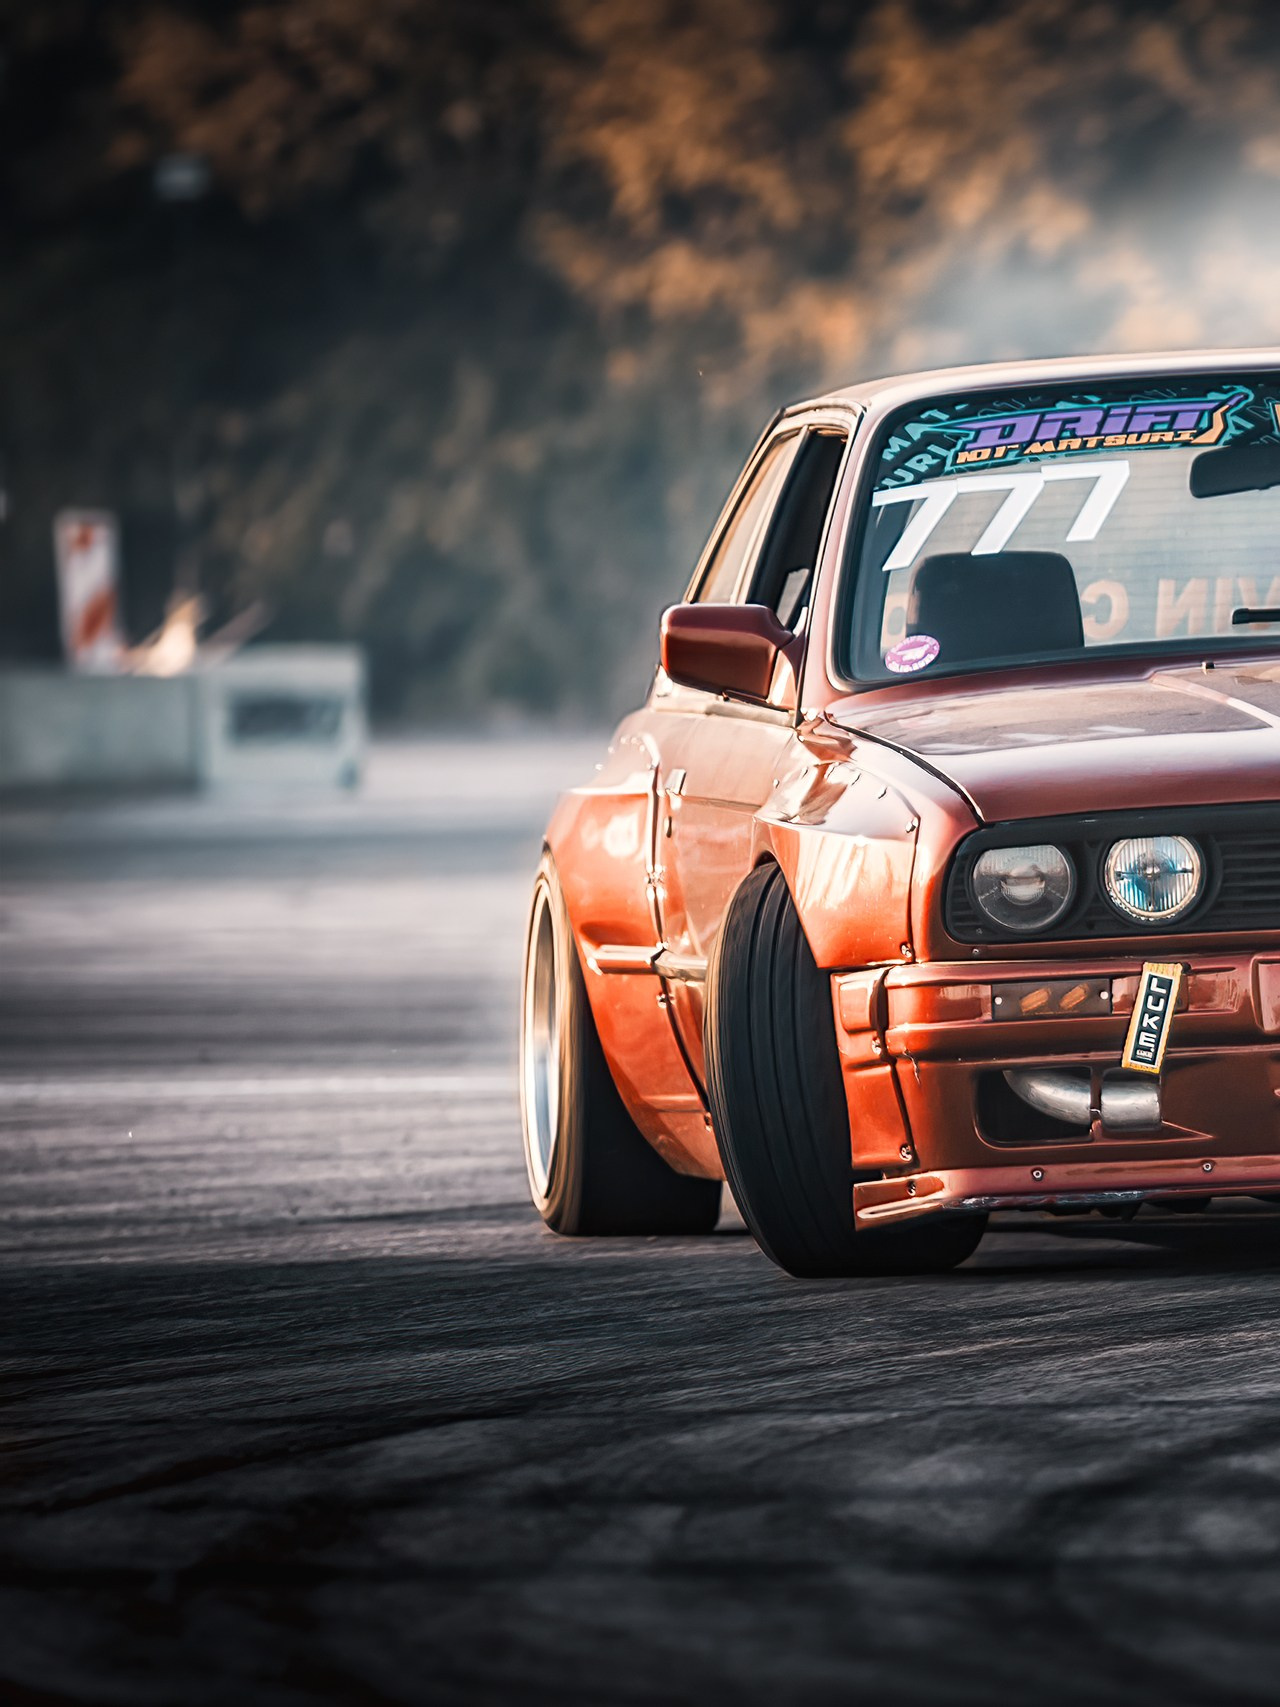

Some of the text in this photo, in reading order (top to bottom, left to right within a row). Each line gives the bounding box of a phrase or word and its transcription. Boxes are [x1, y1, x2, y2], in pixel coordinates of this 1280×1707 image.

[954, 393, 1245, 450] DRIFT
[1023, 429, 1198, 455] MATSURI
[871, 460, 1130, 571] 777
